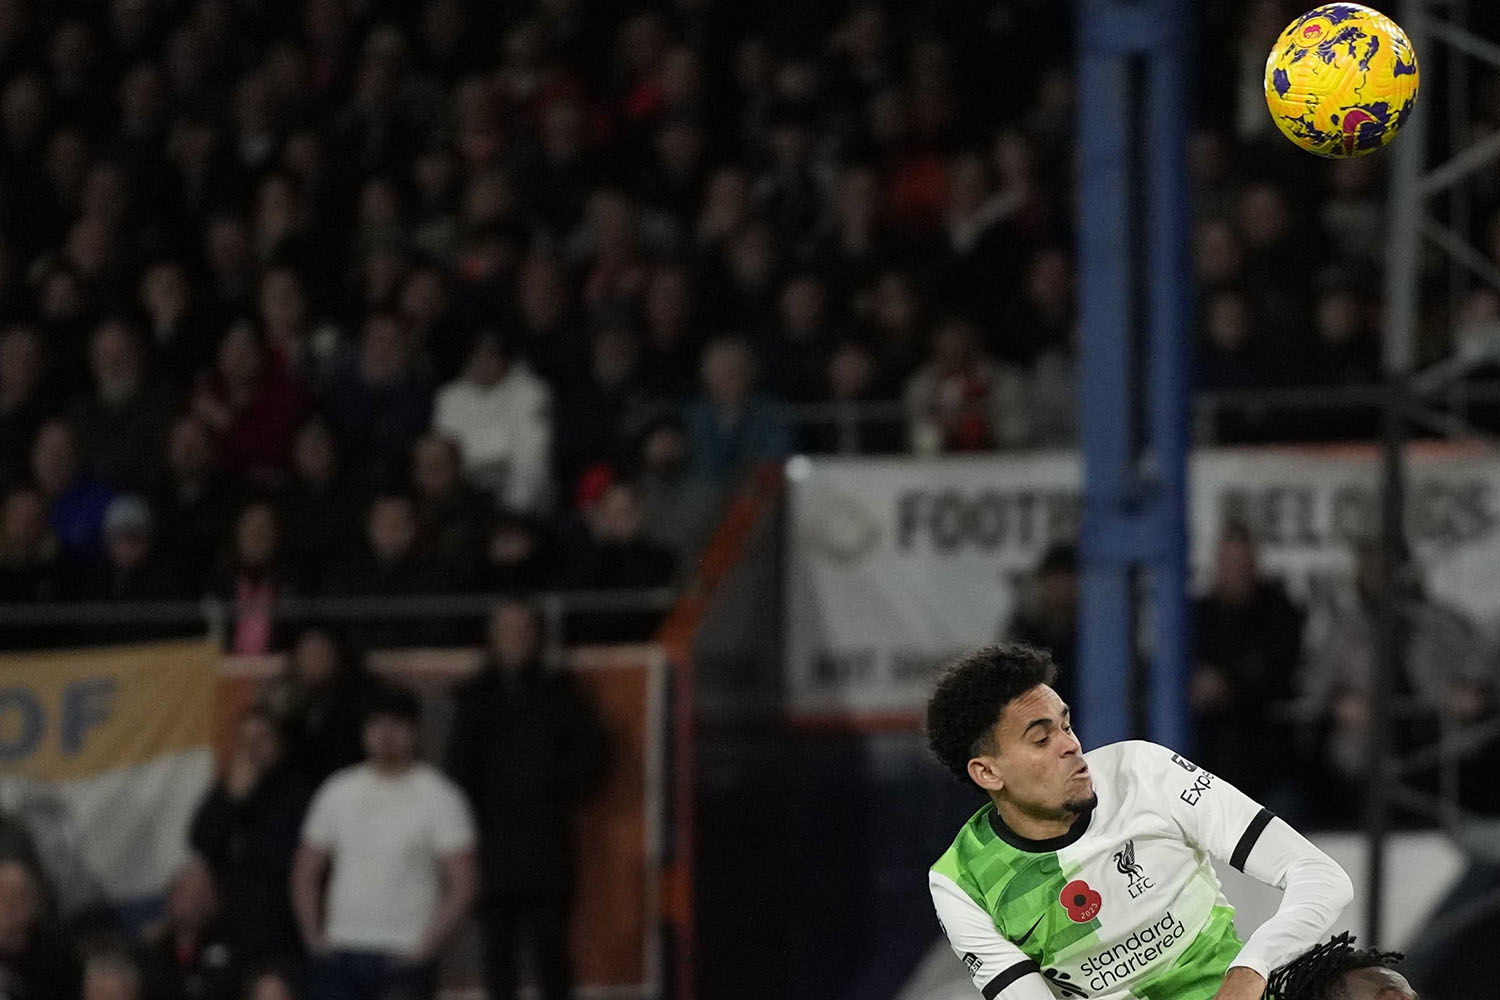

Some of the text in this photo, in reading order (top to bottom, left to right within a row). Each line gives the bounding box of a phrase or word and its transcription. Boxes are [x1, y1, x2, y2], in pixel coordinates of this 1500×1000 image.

[1218, 482, 1496, 547] BELOGS
[1080, 902, 1099, 920] 2023
[1080, 911, 1175, 977] standard
[1090, 920, 1185, 991] chartered
